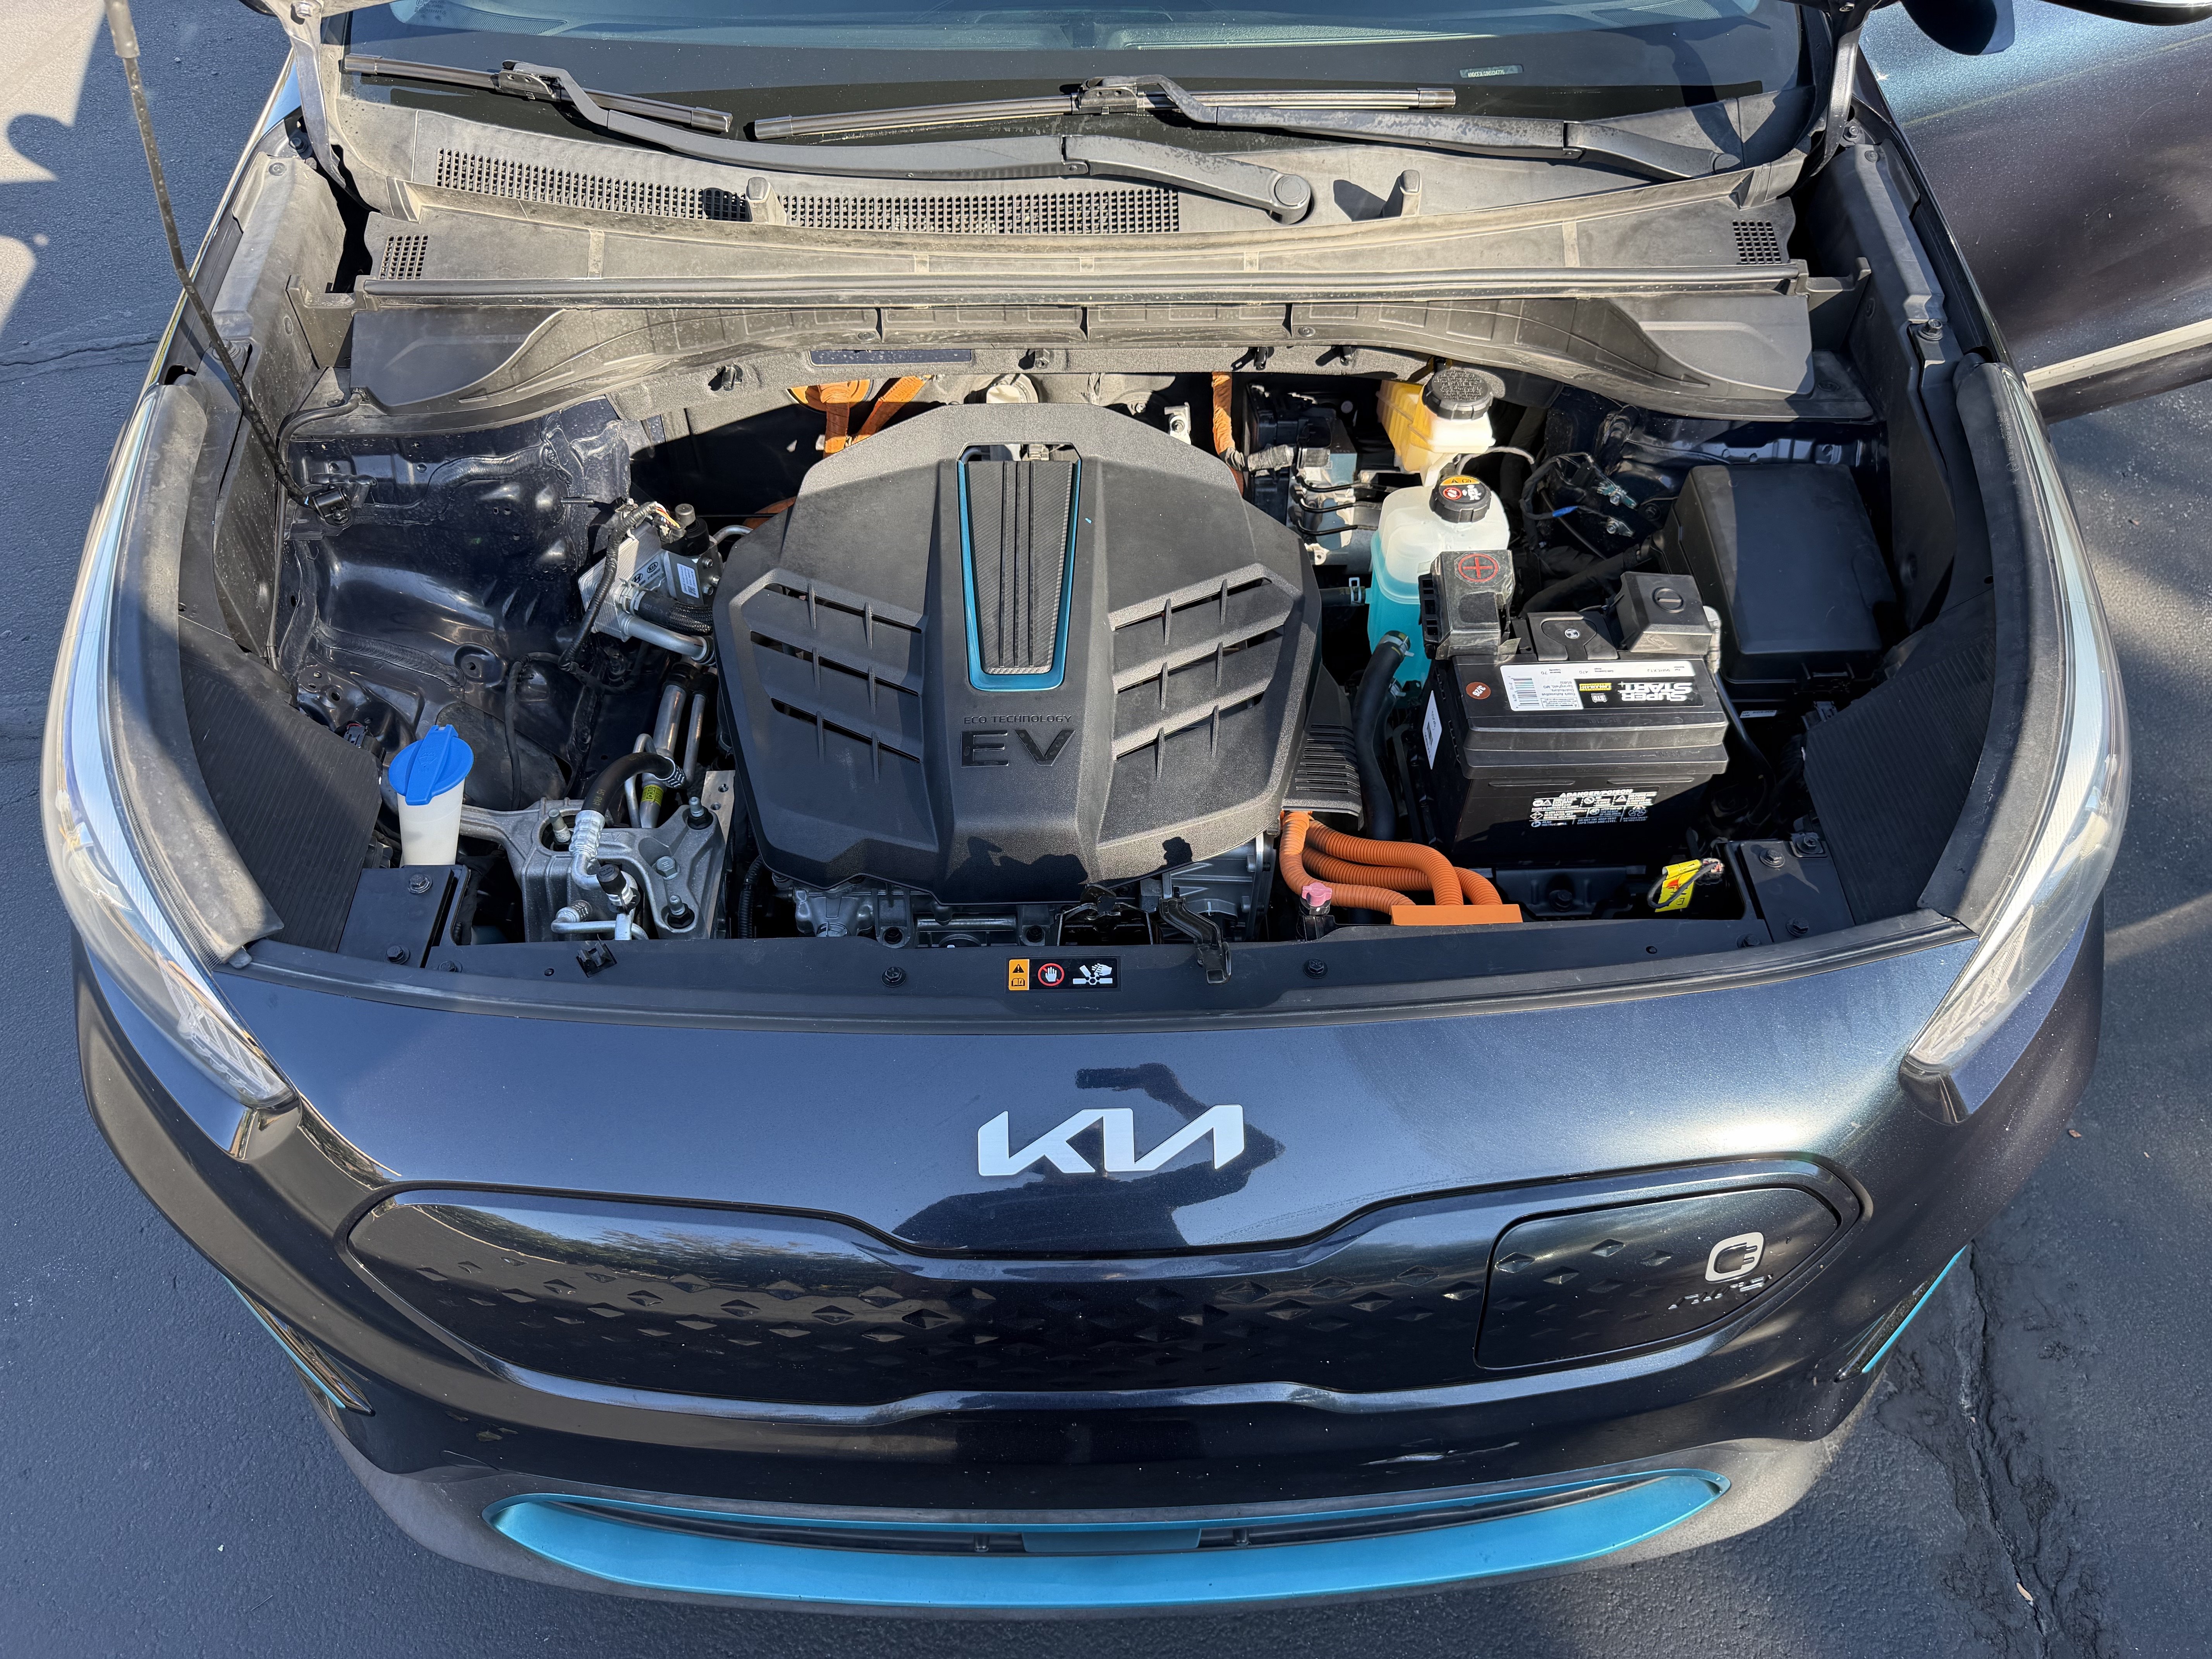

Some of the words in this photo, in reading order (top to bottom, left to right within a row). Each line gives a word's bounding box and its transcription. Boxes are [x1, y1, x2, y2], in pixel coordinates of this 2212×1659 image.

[1618, 682, 1693, 694] START
[1621, 692, 1688, 701] SUPER
[990, 714, 1072, 723] TECHNOLOGY
[960, 729, 1076, 768] EV
[1566, 789, 1633, 797] DANGER/POISON
[977, 1104, 1245, 1176] KIA
